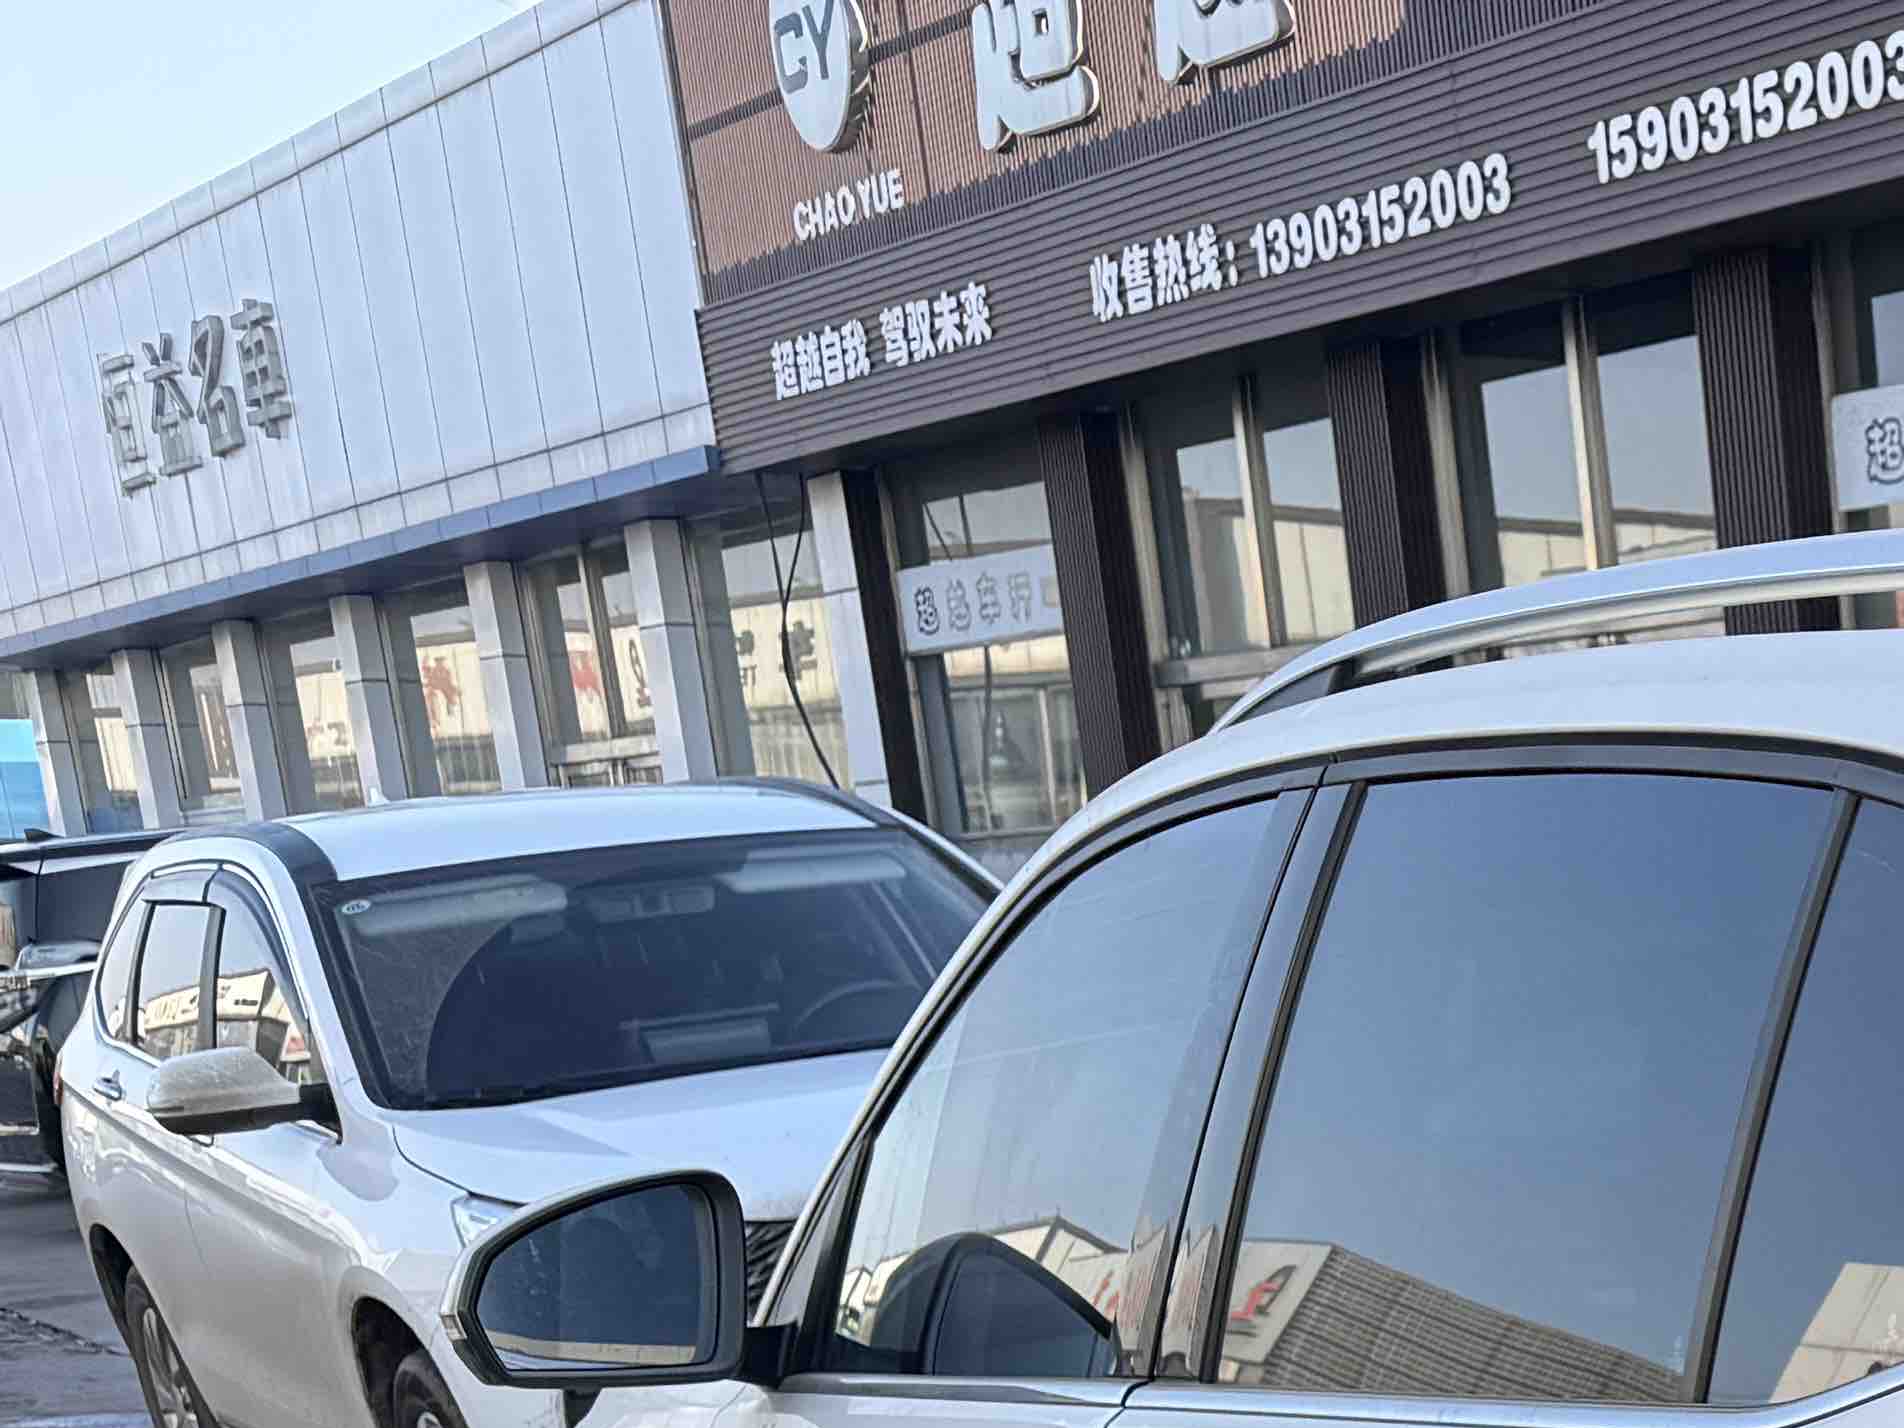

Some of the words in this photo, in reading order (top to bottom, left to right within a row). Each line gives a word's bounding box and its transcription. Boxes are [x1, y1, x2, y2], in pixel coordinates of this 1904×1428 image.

[772, 318, 871, 400] 超越自我
[880, 281, 993, 367] 驾驭未来
